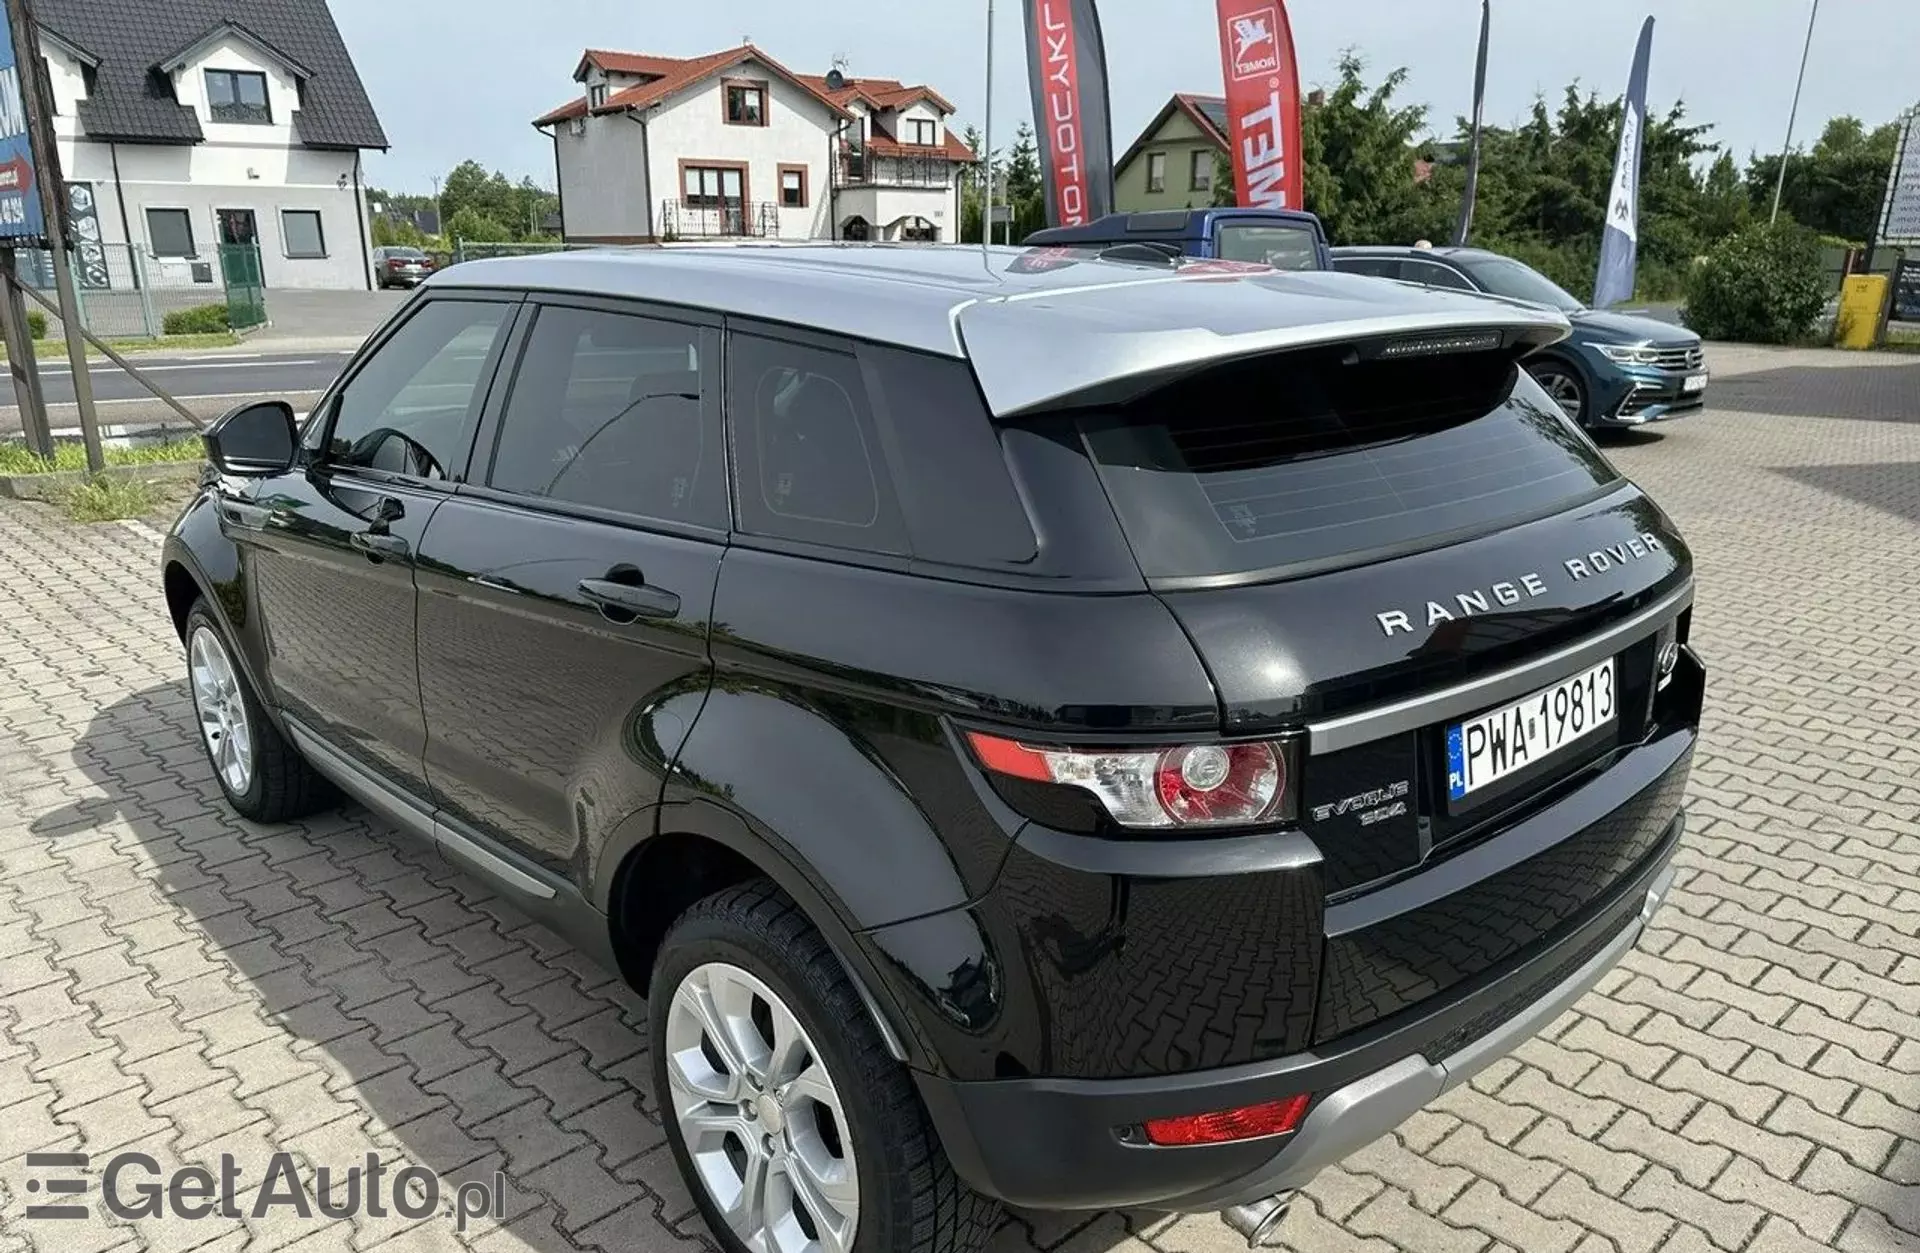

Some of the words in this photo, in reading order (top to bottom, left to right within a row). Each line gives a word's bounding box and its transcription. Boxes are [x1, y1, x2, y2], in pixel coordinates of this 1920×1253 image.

[1376, 573, 1547, 637] RANGE
[1564, 532, 1661, 581] ROVER
[1467, 706, 1528, 786] PWA
[1539, 665, 1613, 750] 19813
[1312, 780, 1409, 821] EVOQUE
[1449, 770, 1464, 790] PL
